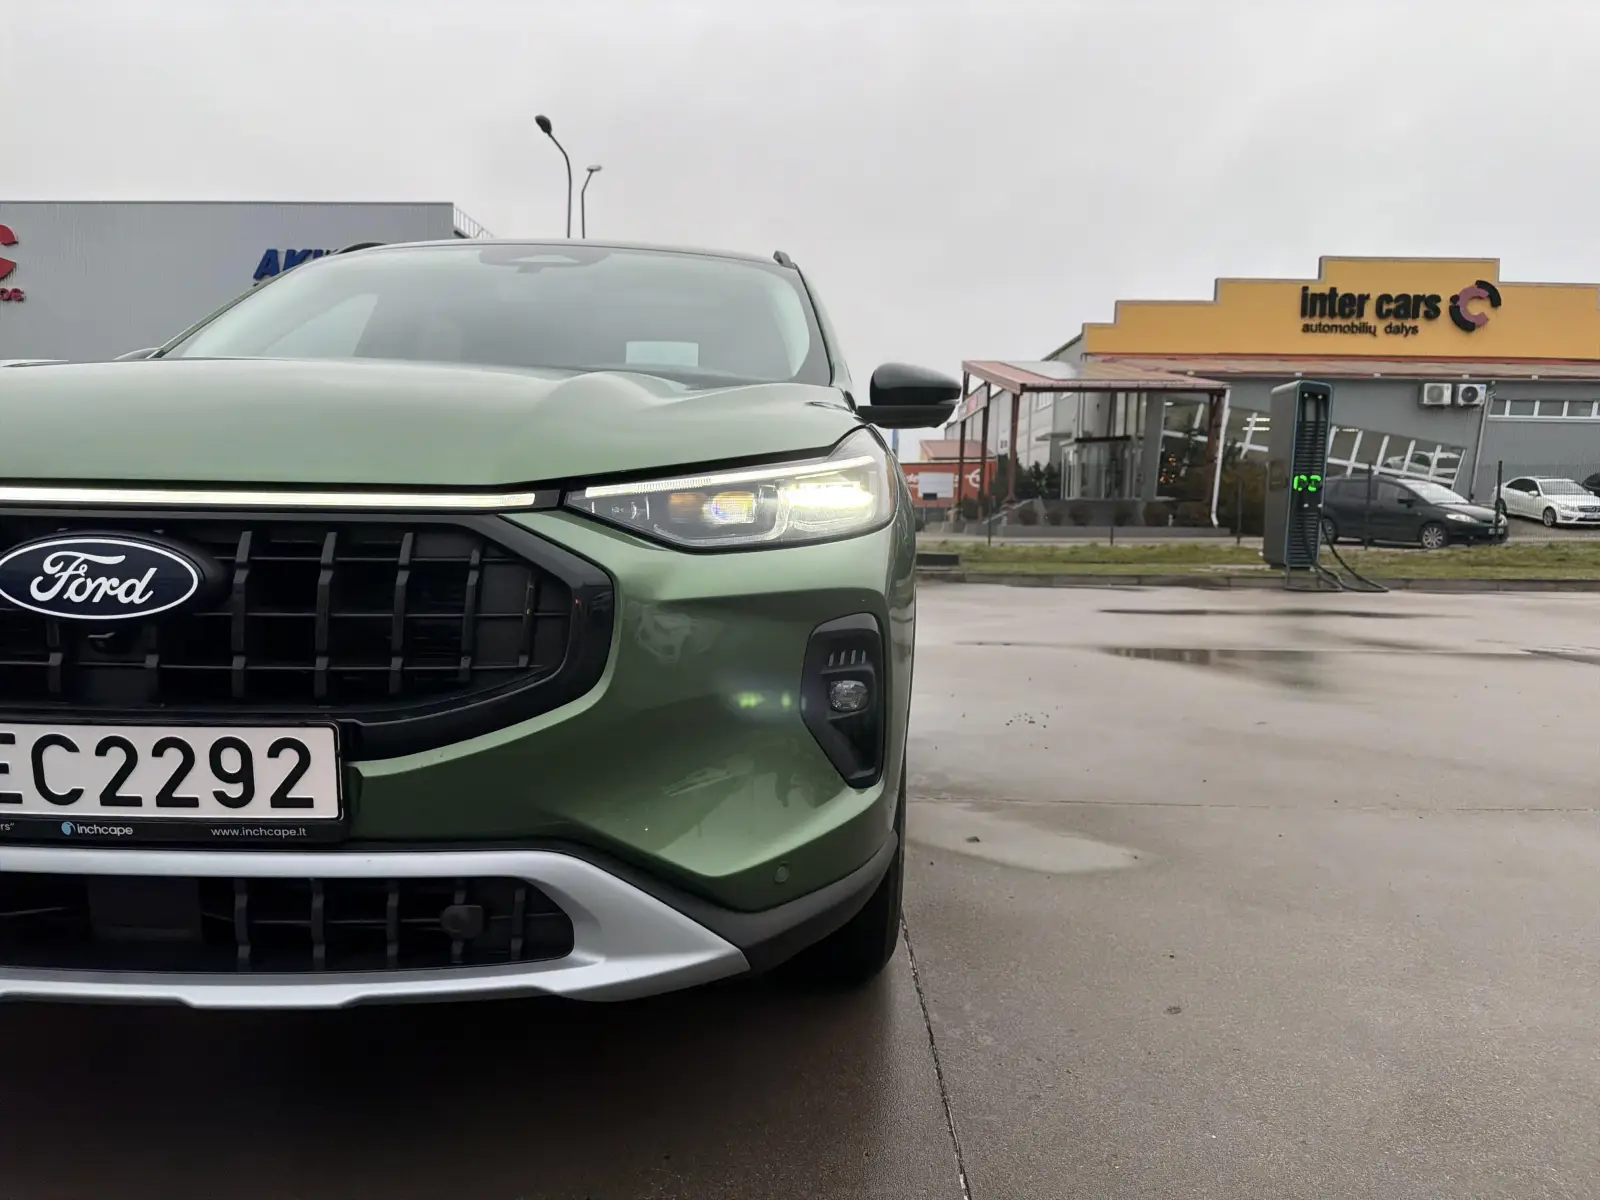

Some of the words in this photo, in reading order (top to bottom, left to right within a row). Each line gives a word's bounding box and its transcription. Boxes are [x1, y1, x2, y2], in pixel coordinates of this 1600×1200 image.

[1301, 286, 1370, 321] inter
[1375, 293, 1442, 321] cars
[1302, 322, 1377, 337] automobilių
[1384, 322, 1419, 337] dalys
[30, 551, 157, 605] Ford
[76, 823, 133, 837] inchcape
[210, 826, 307, 838] www.inchcape.lt
